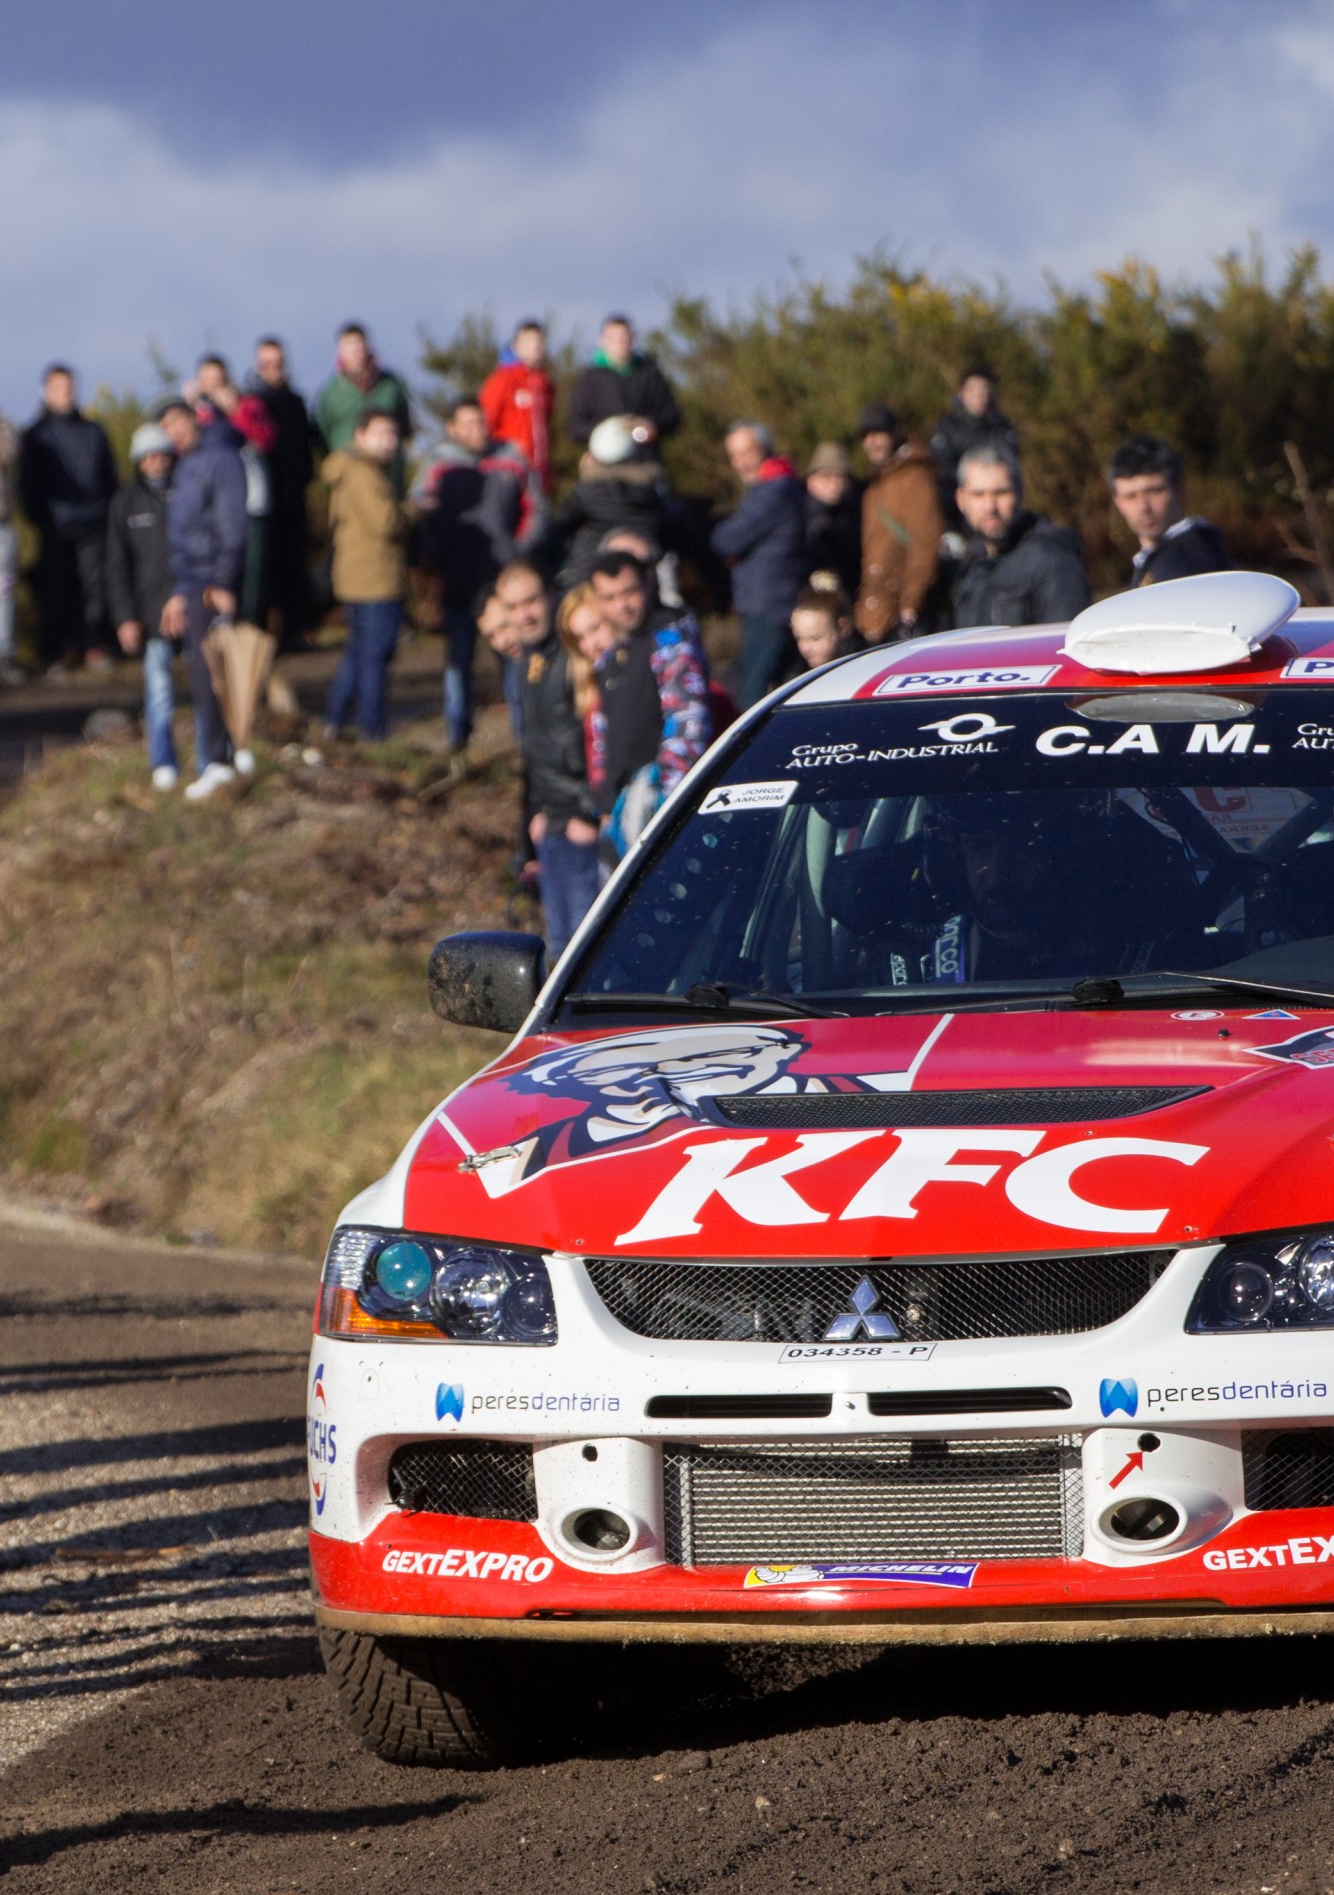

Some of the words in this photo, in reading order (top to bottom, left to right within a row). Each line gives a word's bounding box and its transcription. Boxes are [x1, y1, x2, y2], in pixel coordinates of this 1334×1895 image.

[897, 671, 1031, 688] Porto.
[785, 742, 999, 769] AUTO-INDUSTRIAL
[791, 743, 859, 756] Grupo
[742, 787, 785, 795] JORGE
[733, 795, 784, 803] AMORIM
[615, 1128, 1211, 1245] KFC
[787, 1347, 884, 1358] 034358
[382, 1549, 554, 1583] GEXTEXPRO
[827, 1565, 974, 1574] MICHELIN
